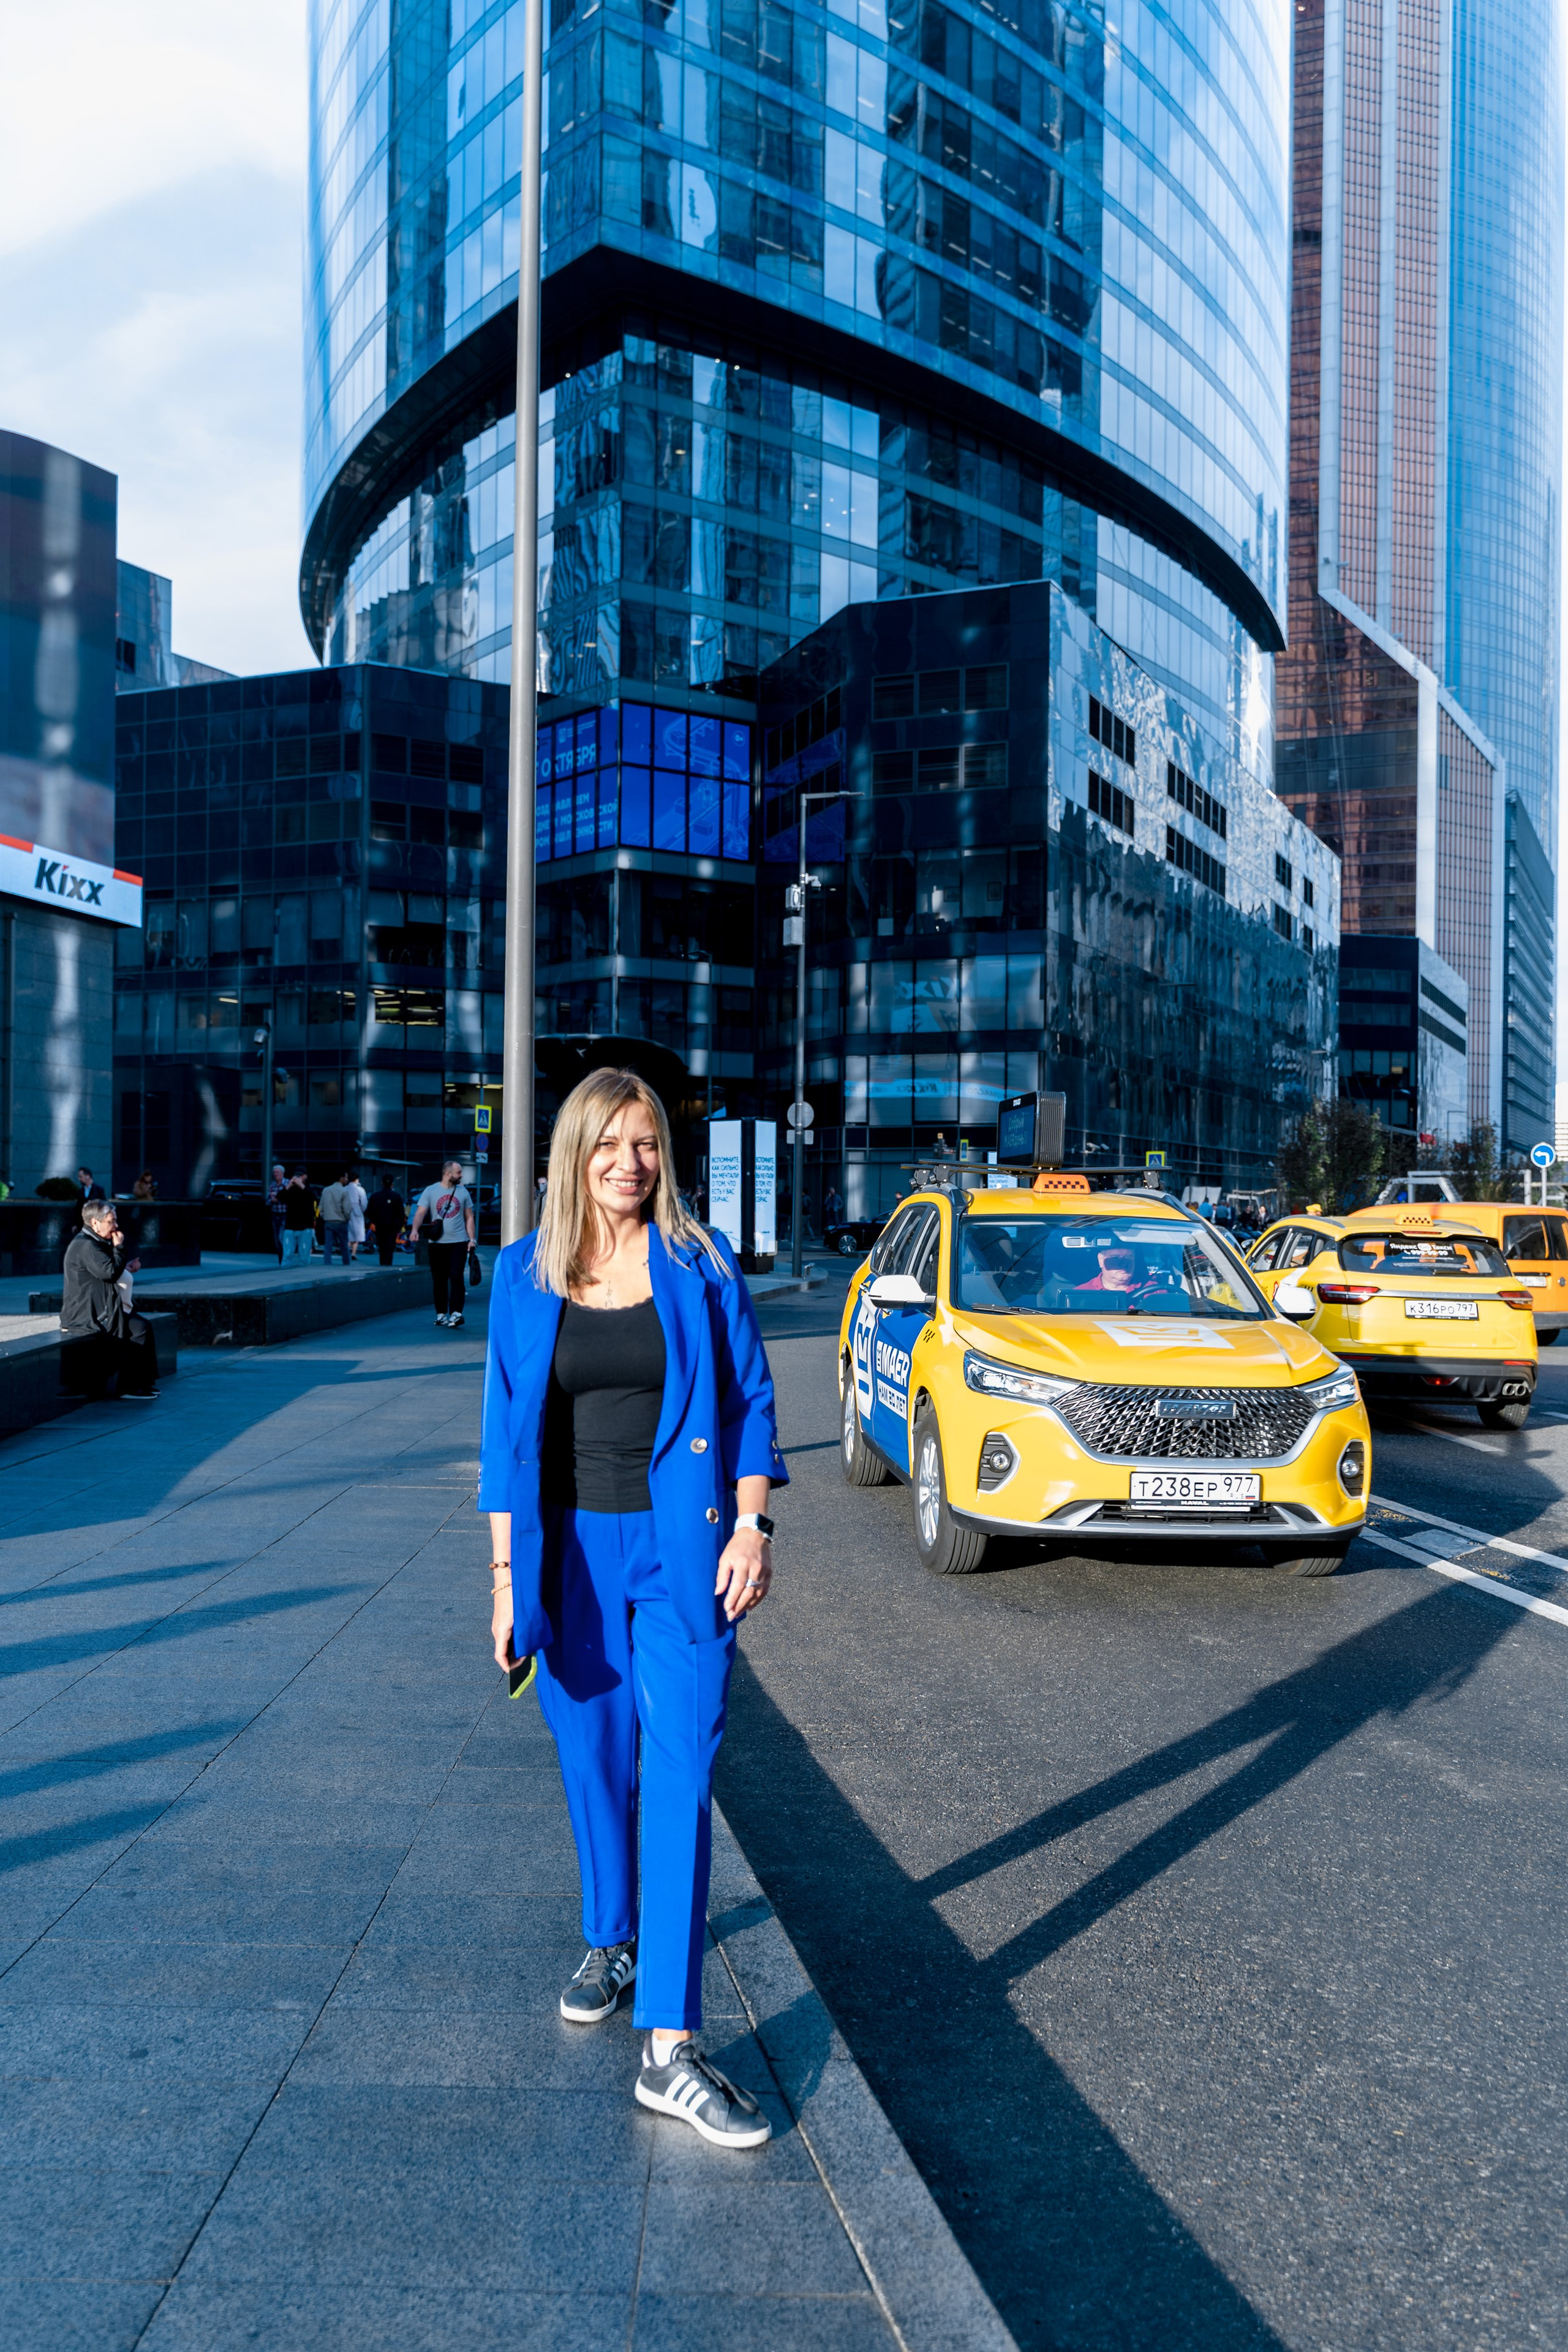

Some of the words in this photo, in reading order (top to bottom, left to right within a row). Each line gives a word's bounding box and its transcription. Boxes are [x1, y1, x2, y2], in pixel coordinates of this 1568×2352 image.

[34, 857, 105, 907] Kixx
[882, 1343, 910, 1388] MAER
[1162, 1404, 1232, 1415] HAVAL
[1224, 1477, 1254, 1493] 977
